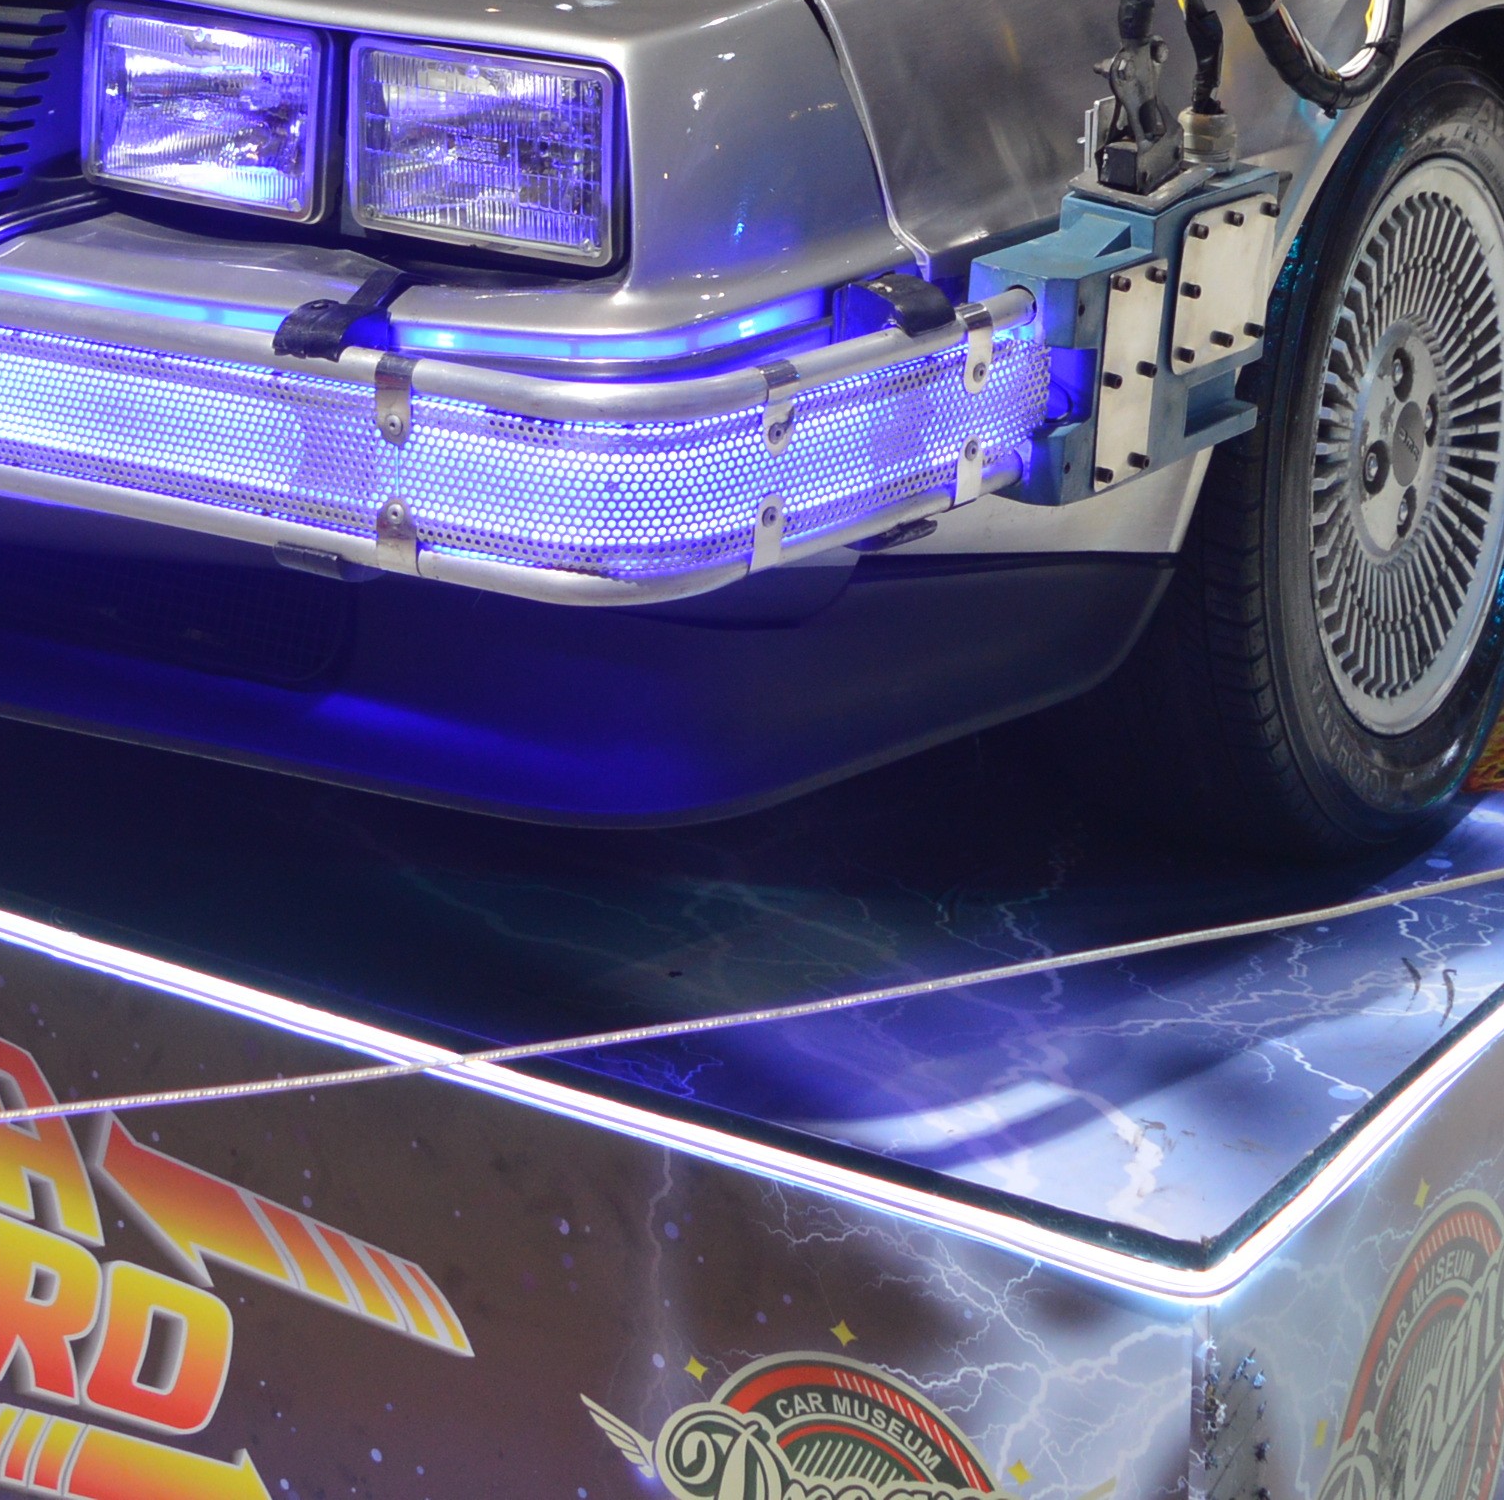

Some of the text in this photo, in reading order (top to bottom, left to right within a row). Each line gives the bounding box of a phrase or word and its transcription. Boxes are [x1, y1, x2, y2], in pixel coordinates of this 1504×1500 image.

[1375, 1248, 1475, 1388] CAR MUSEUM
[775, 1394, 826, 1421] CAR
[832, 1395, 942, 1473] MUSEUM
